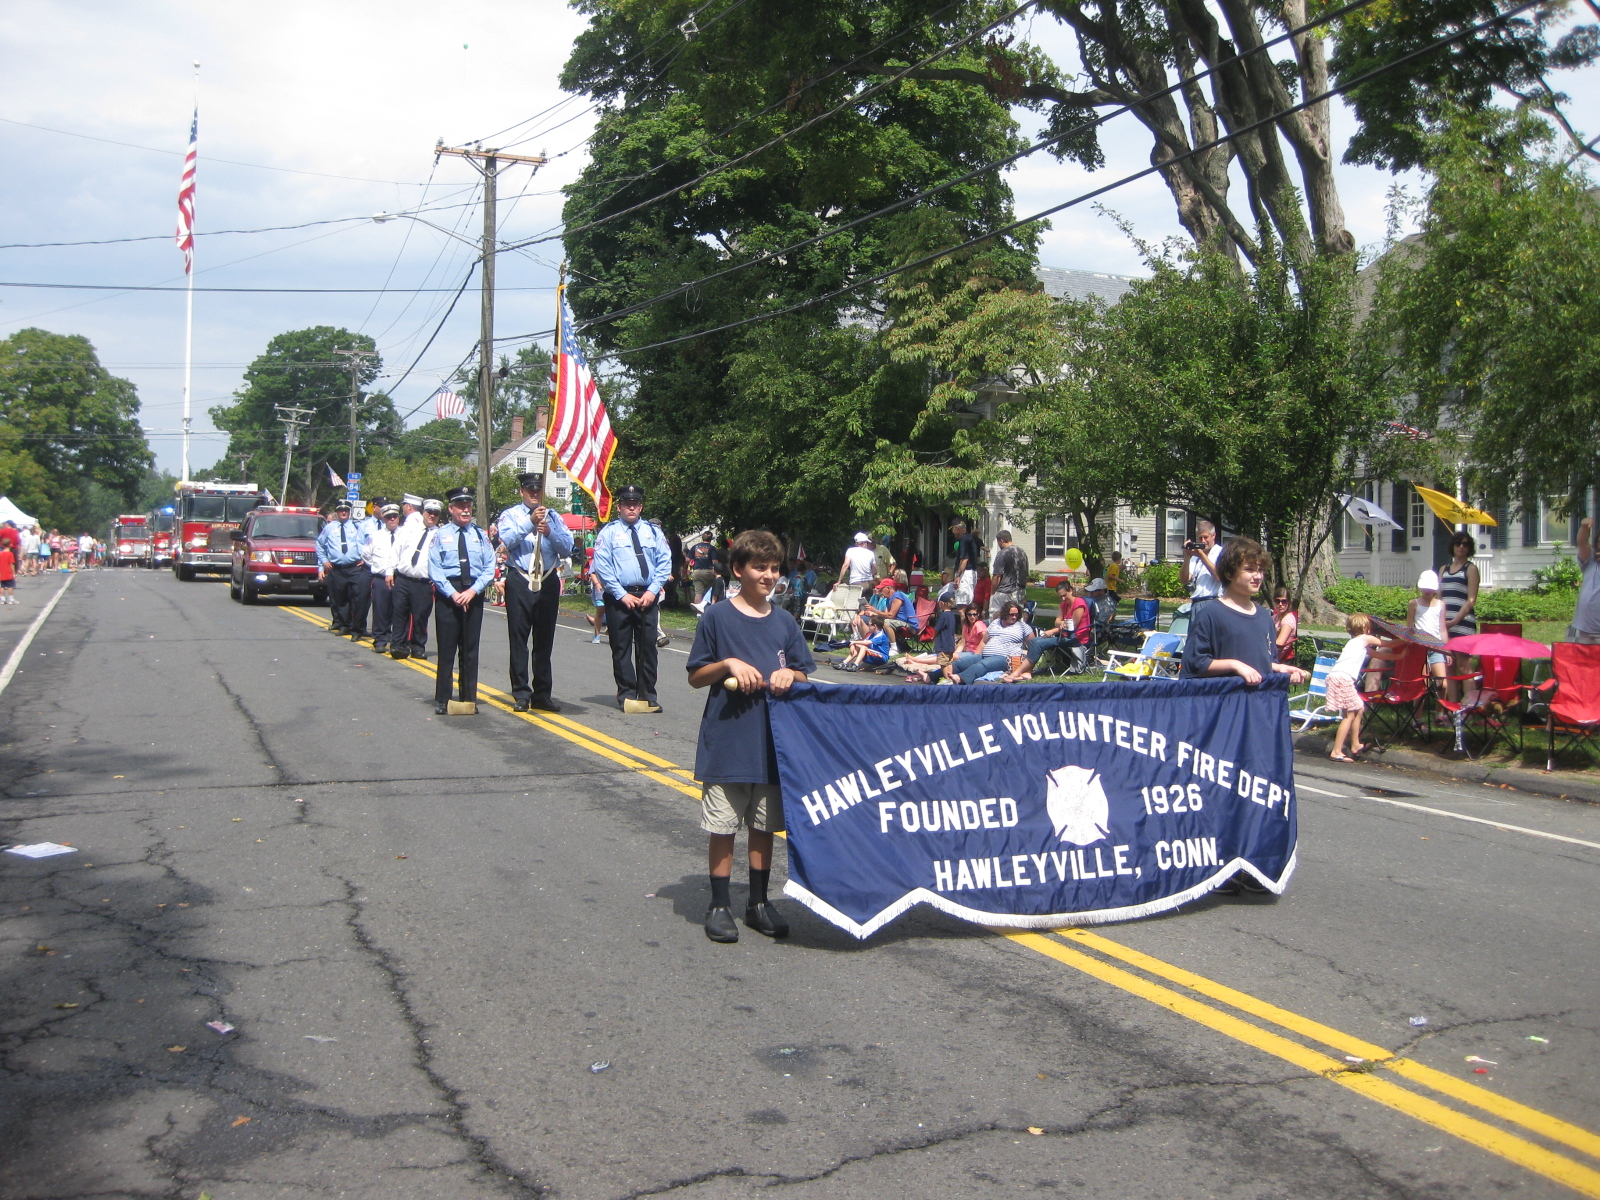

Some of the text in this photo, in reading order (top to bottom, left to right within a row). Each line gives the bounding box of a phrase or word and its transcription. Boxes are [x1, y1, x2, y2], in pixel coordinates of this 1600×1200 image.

[801, 723, 1002, 826] HAWLEYVILLE
[1002, 711, 1167, 762] VOLUNTEER
[1177, 741, 1234, 790] FIRE
[878, 797, 1019, 833] FOUNDED
[1141, 783, 1203, 815] 1926
[933, 836, 1224, 892] HAWLEYVILLE, CONN.
